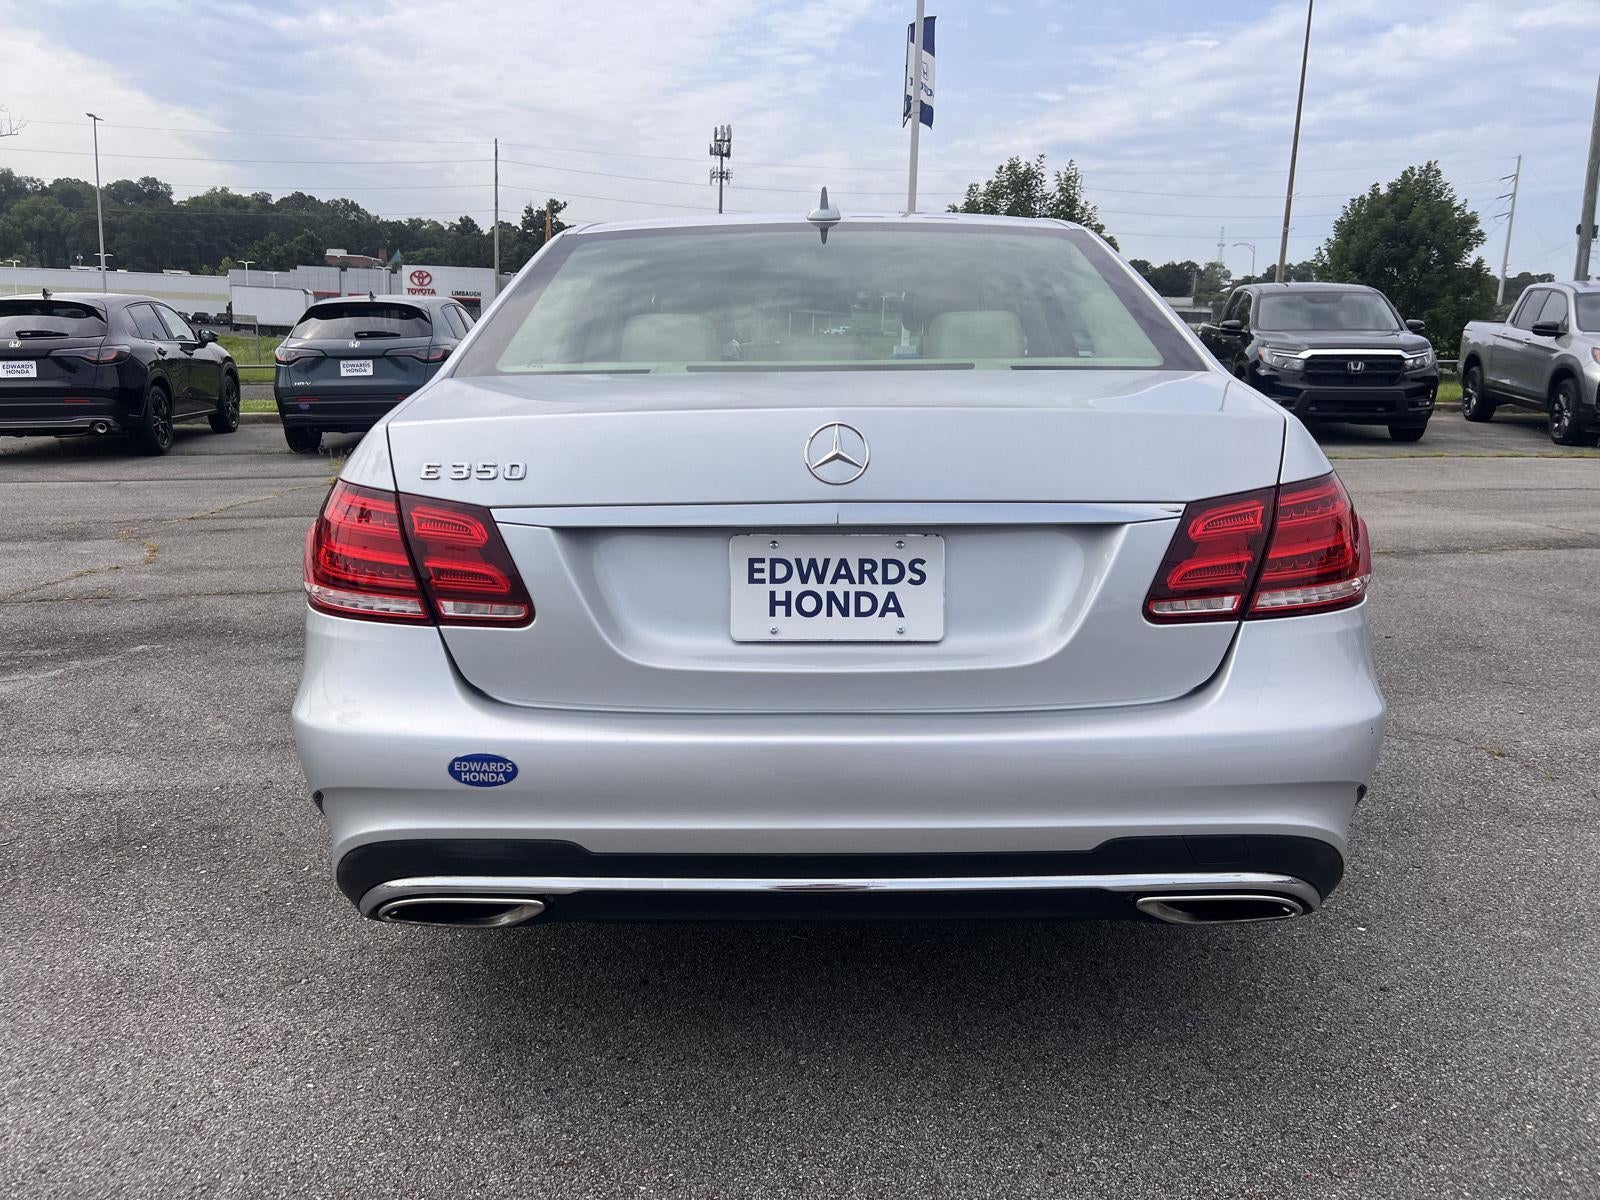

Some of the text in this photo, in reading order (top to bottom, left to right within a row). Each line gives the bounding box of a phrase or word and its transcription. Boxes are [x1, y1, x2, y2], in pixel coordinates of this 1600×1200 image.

[420, 462, 527, 480] E 350
[747, 557, 927, 586] EDWARDS
[768, 590, 905, 618] HONDA
[454, 761, 513, 772] EDWARDS
[461, 772, 506, 782] HONDA
